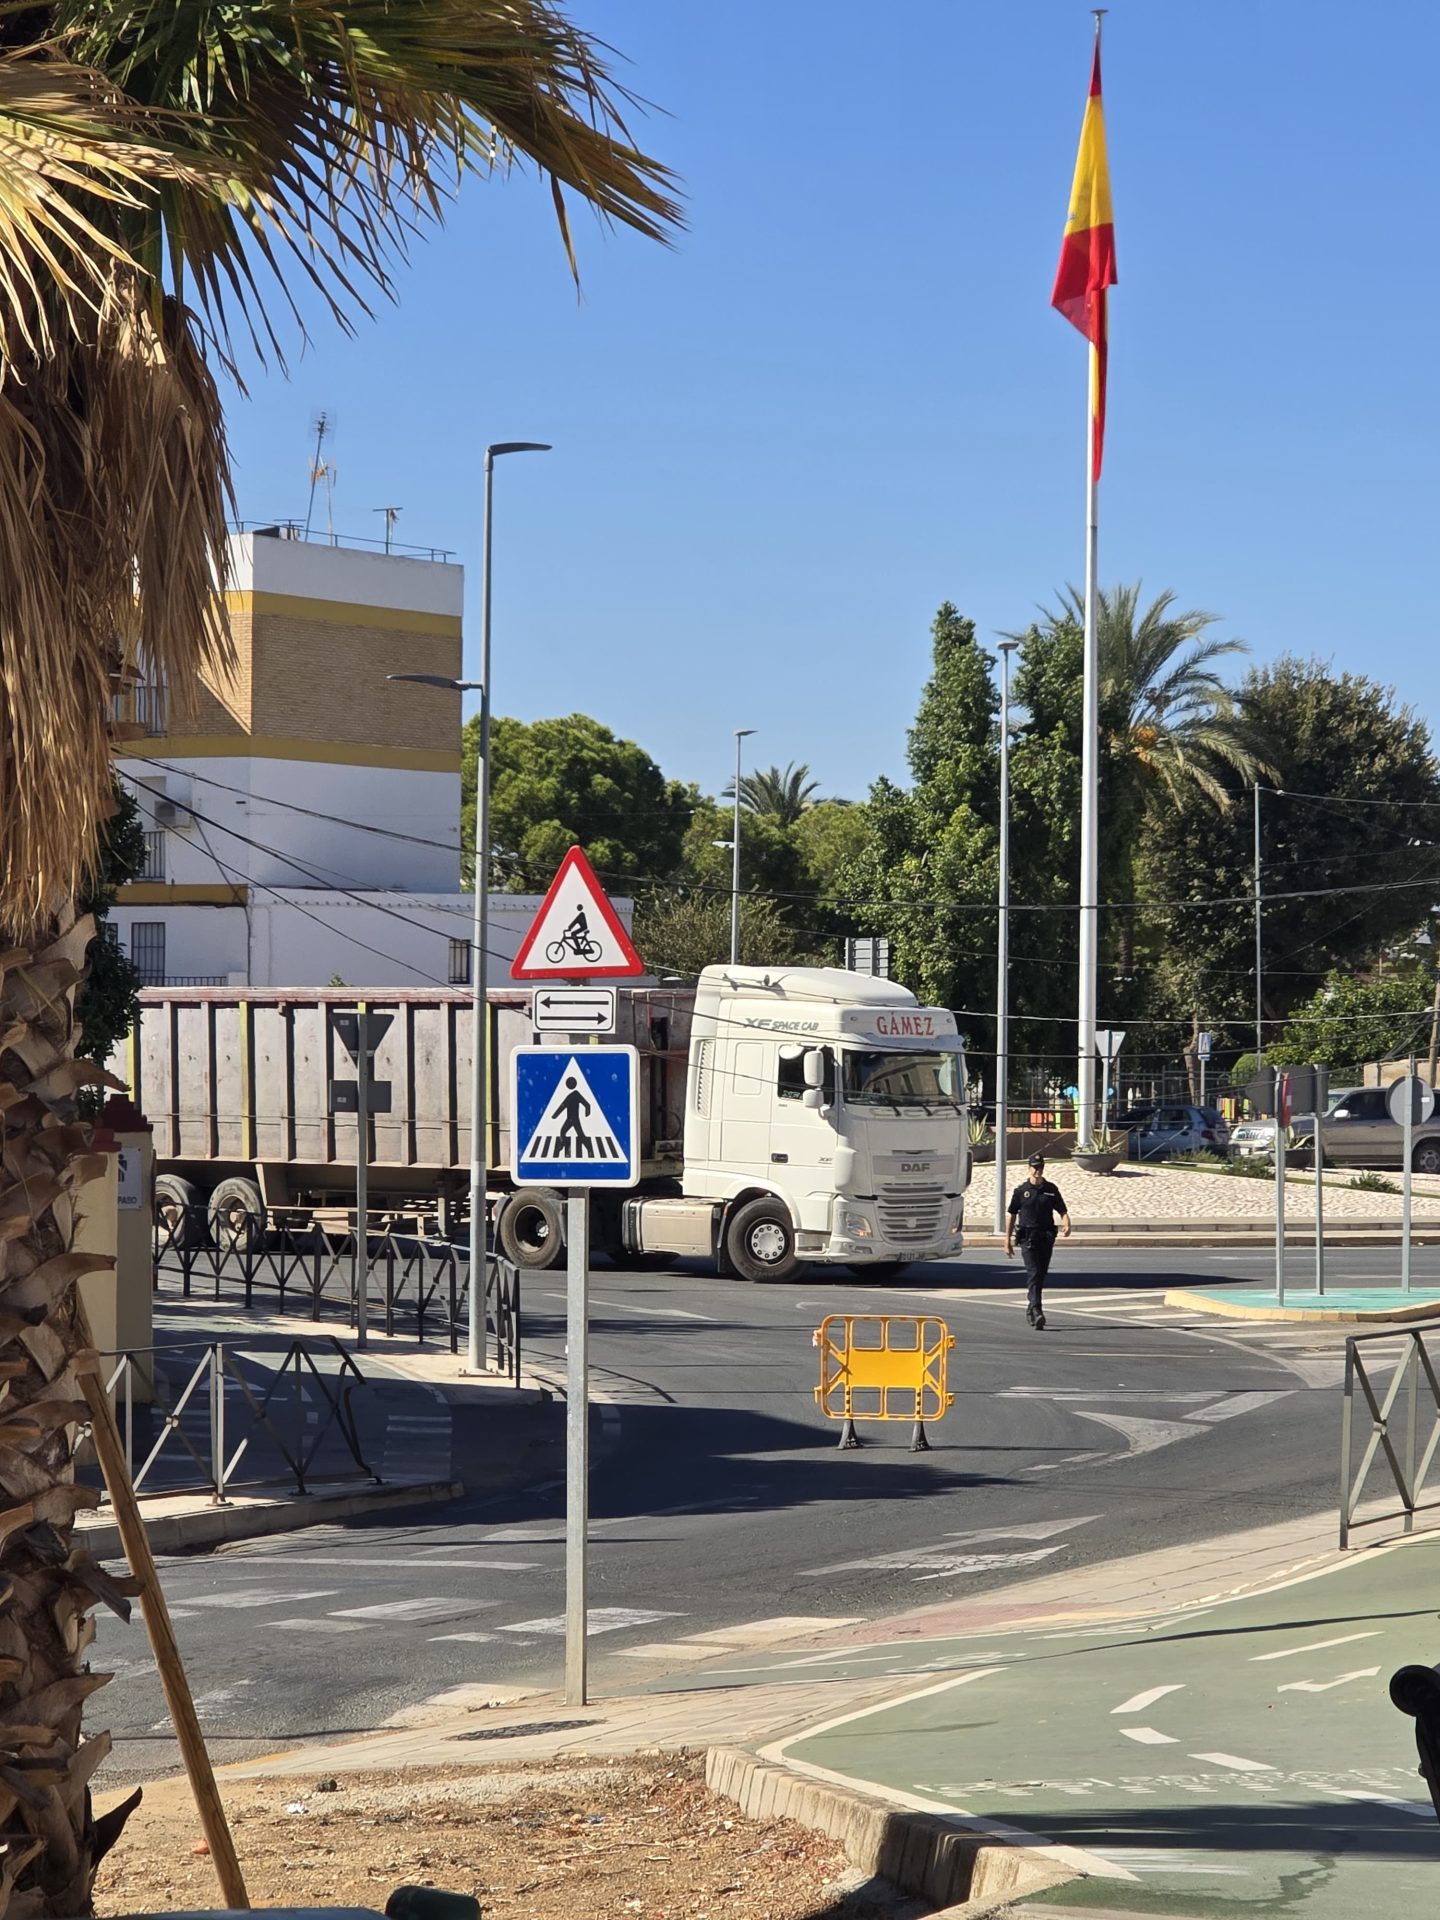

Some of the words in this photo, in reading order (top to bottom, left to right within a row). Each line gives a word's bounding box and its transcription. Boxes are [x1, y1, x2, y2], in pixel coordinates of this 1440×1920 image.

[772, 1020, 801, 1031] SPACE
[801, 1021, 820, 1031] CAB
[901, 1163, 930, 1172] DAF
